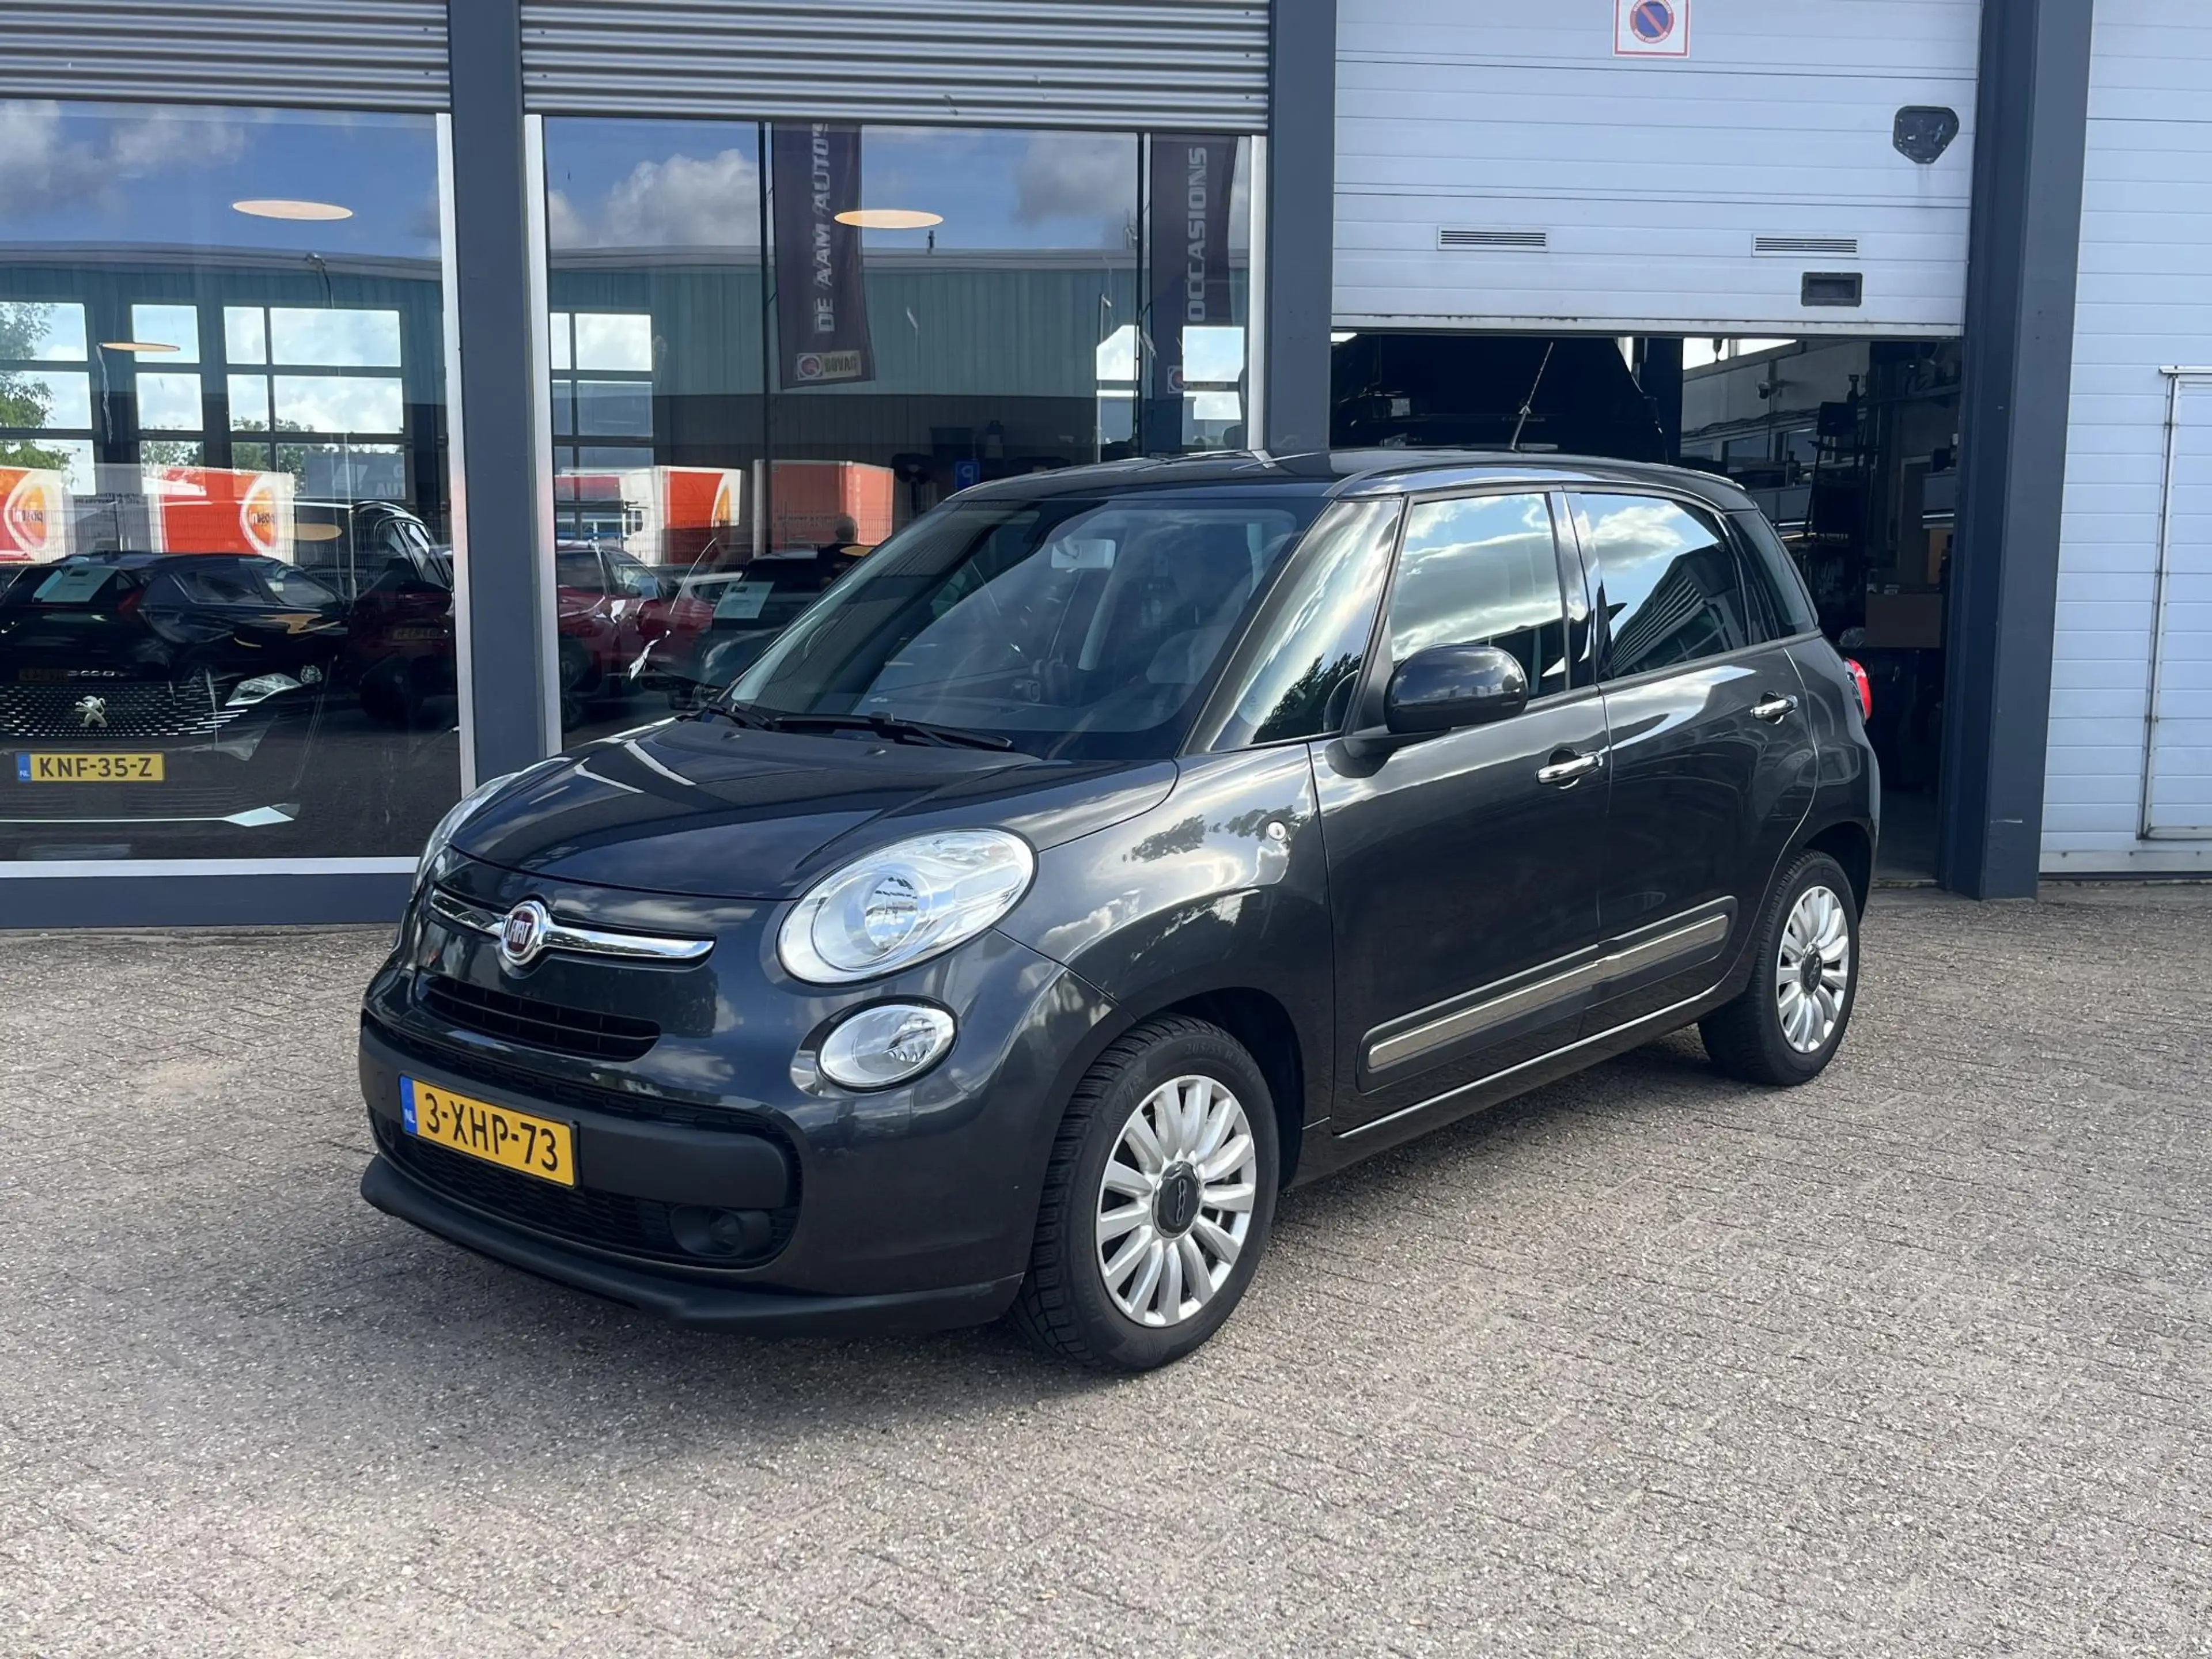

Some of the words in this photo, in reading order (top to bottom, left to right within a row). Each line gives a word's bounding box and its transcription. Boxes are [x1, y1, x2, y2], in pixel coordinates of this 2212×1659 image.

[814, 224, 832, 287] AAM
[1188, 147, 1207, 321] OCCASIONS
[816, 298, 835, 332] DE
[40, 757, 152, 777] KNF-35-Z
[509, 919, 532, 945] FIAT
[405, 1108, 415, 1123] NL
[425, 1093, 558, 1172] 3-XHP-73
